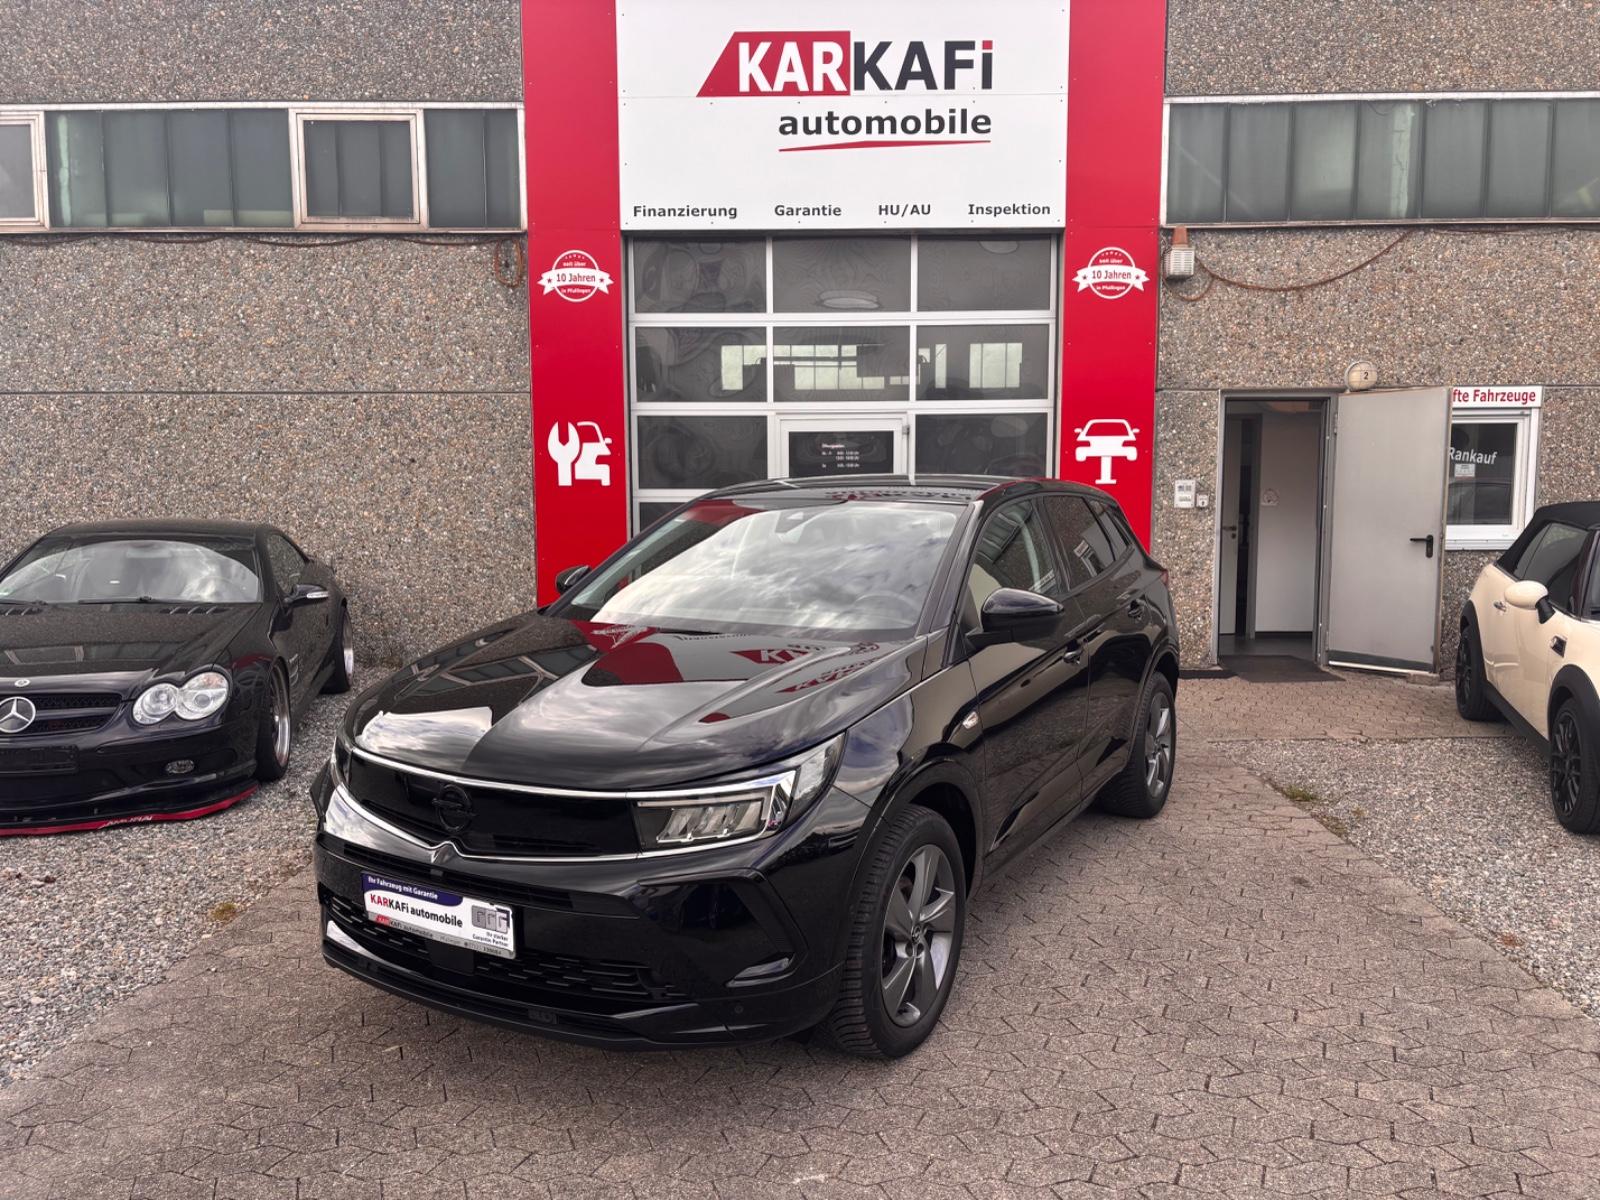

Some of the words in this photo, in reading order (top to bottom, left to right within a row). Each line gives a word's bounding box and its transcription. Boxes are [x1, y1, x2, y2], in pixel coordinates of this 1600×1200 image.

[737, 40, 993, 93] KARKAFi
[778, 108, 992, 136] automobile
[633, 205, 738, 220] Finanzierung
[774, 204, 842, 217] Garantie
[878, 204, 931, 217] HU/AU
[968, 203, 1051, 218] Inspektion
[556, 273, 567, 282] 10
[568, 272, 596, 283] Jahren
[1092, 270, 1102, 280] 10
[1104, 269, 1132, 280] Jahren
[1363, 371, 1369, 380] 2
[1473, 389, 1536, 405] Fahrzeuge
[367, 876, 376, 884] Ihr
[377, 878, 402, 892] Fahrzeug
[403, 885, 413, 893] mit
[413, 887, 438, 900] Garantie
[370, 893, 409, 914] KARKAFi
[410, 906, 463, 928] automobile
